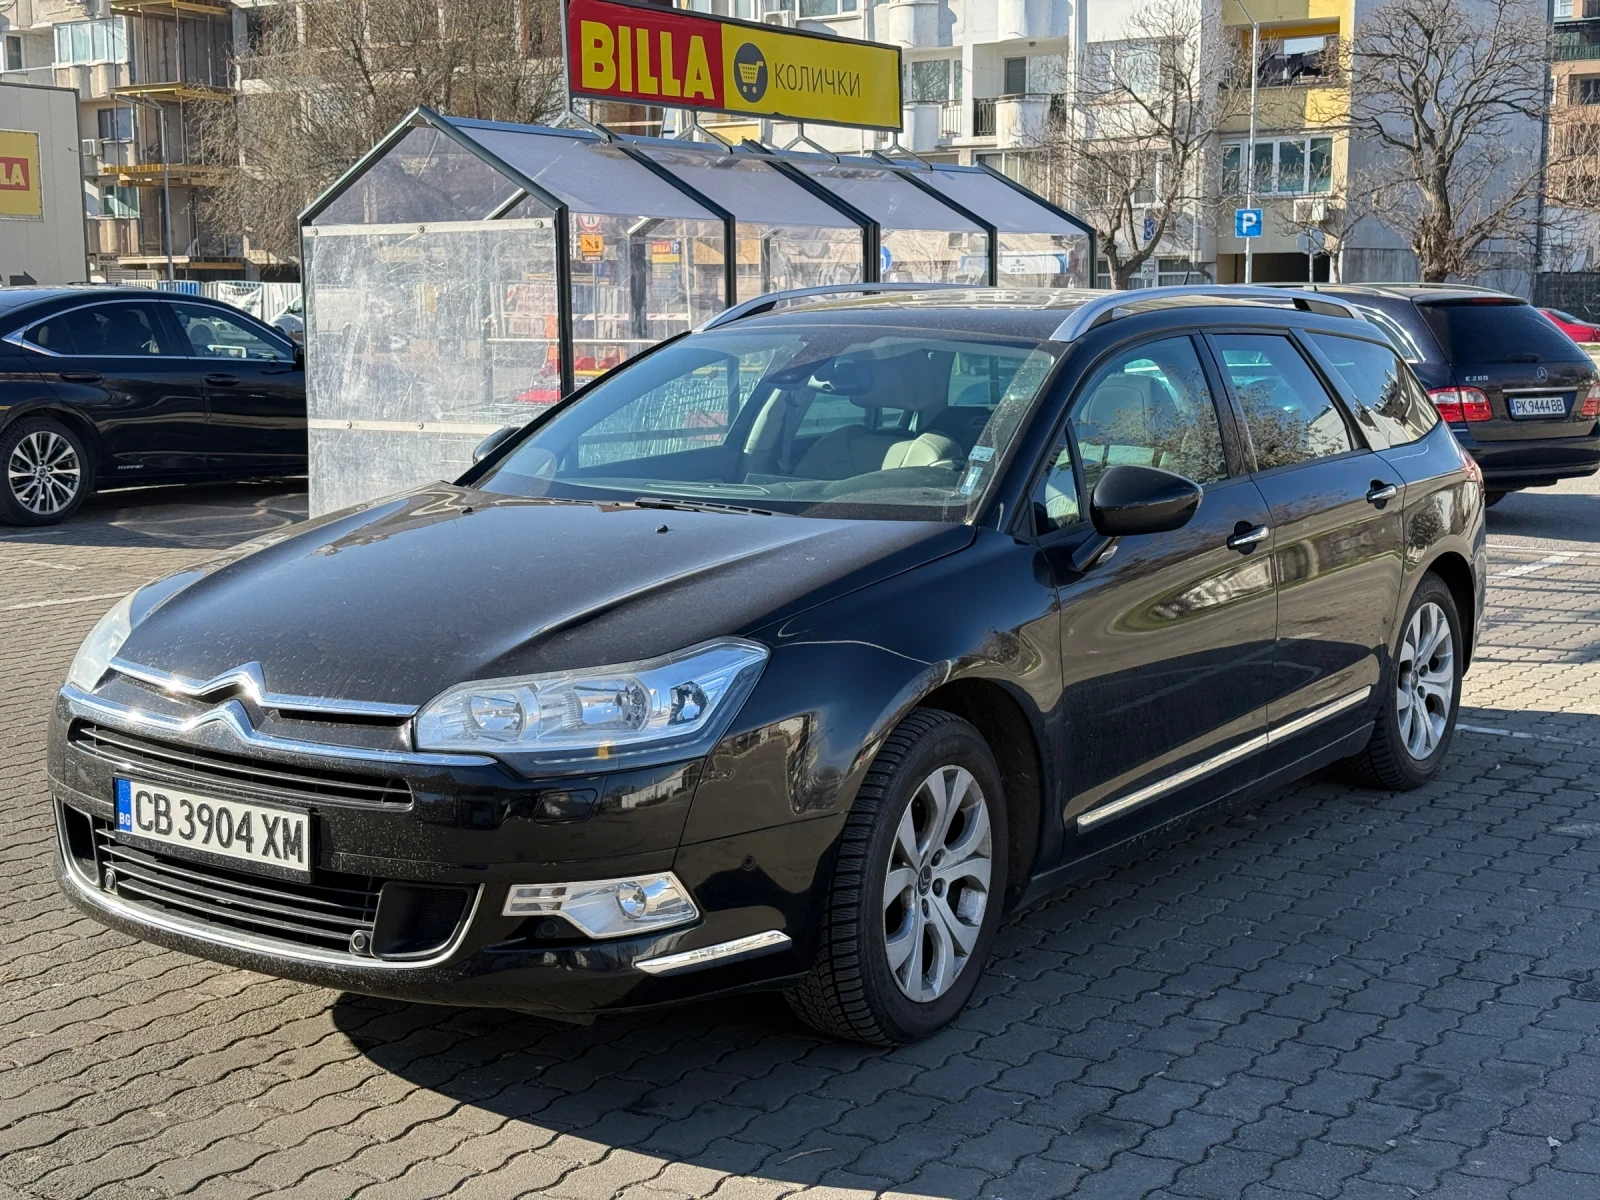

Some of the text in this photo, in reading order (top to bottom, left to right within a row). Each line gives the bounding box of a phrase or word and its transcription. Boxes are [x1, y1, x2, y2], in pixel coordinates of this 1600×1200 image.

[580, 19, 715, 100] BILLA
[774, 62, 861, 98] КОЛИЧКИ
[1242, 212, 1257, 234] P
[119, 812, 131, 826] BG
[135, 790, 304, 864] CB 3904 XM
